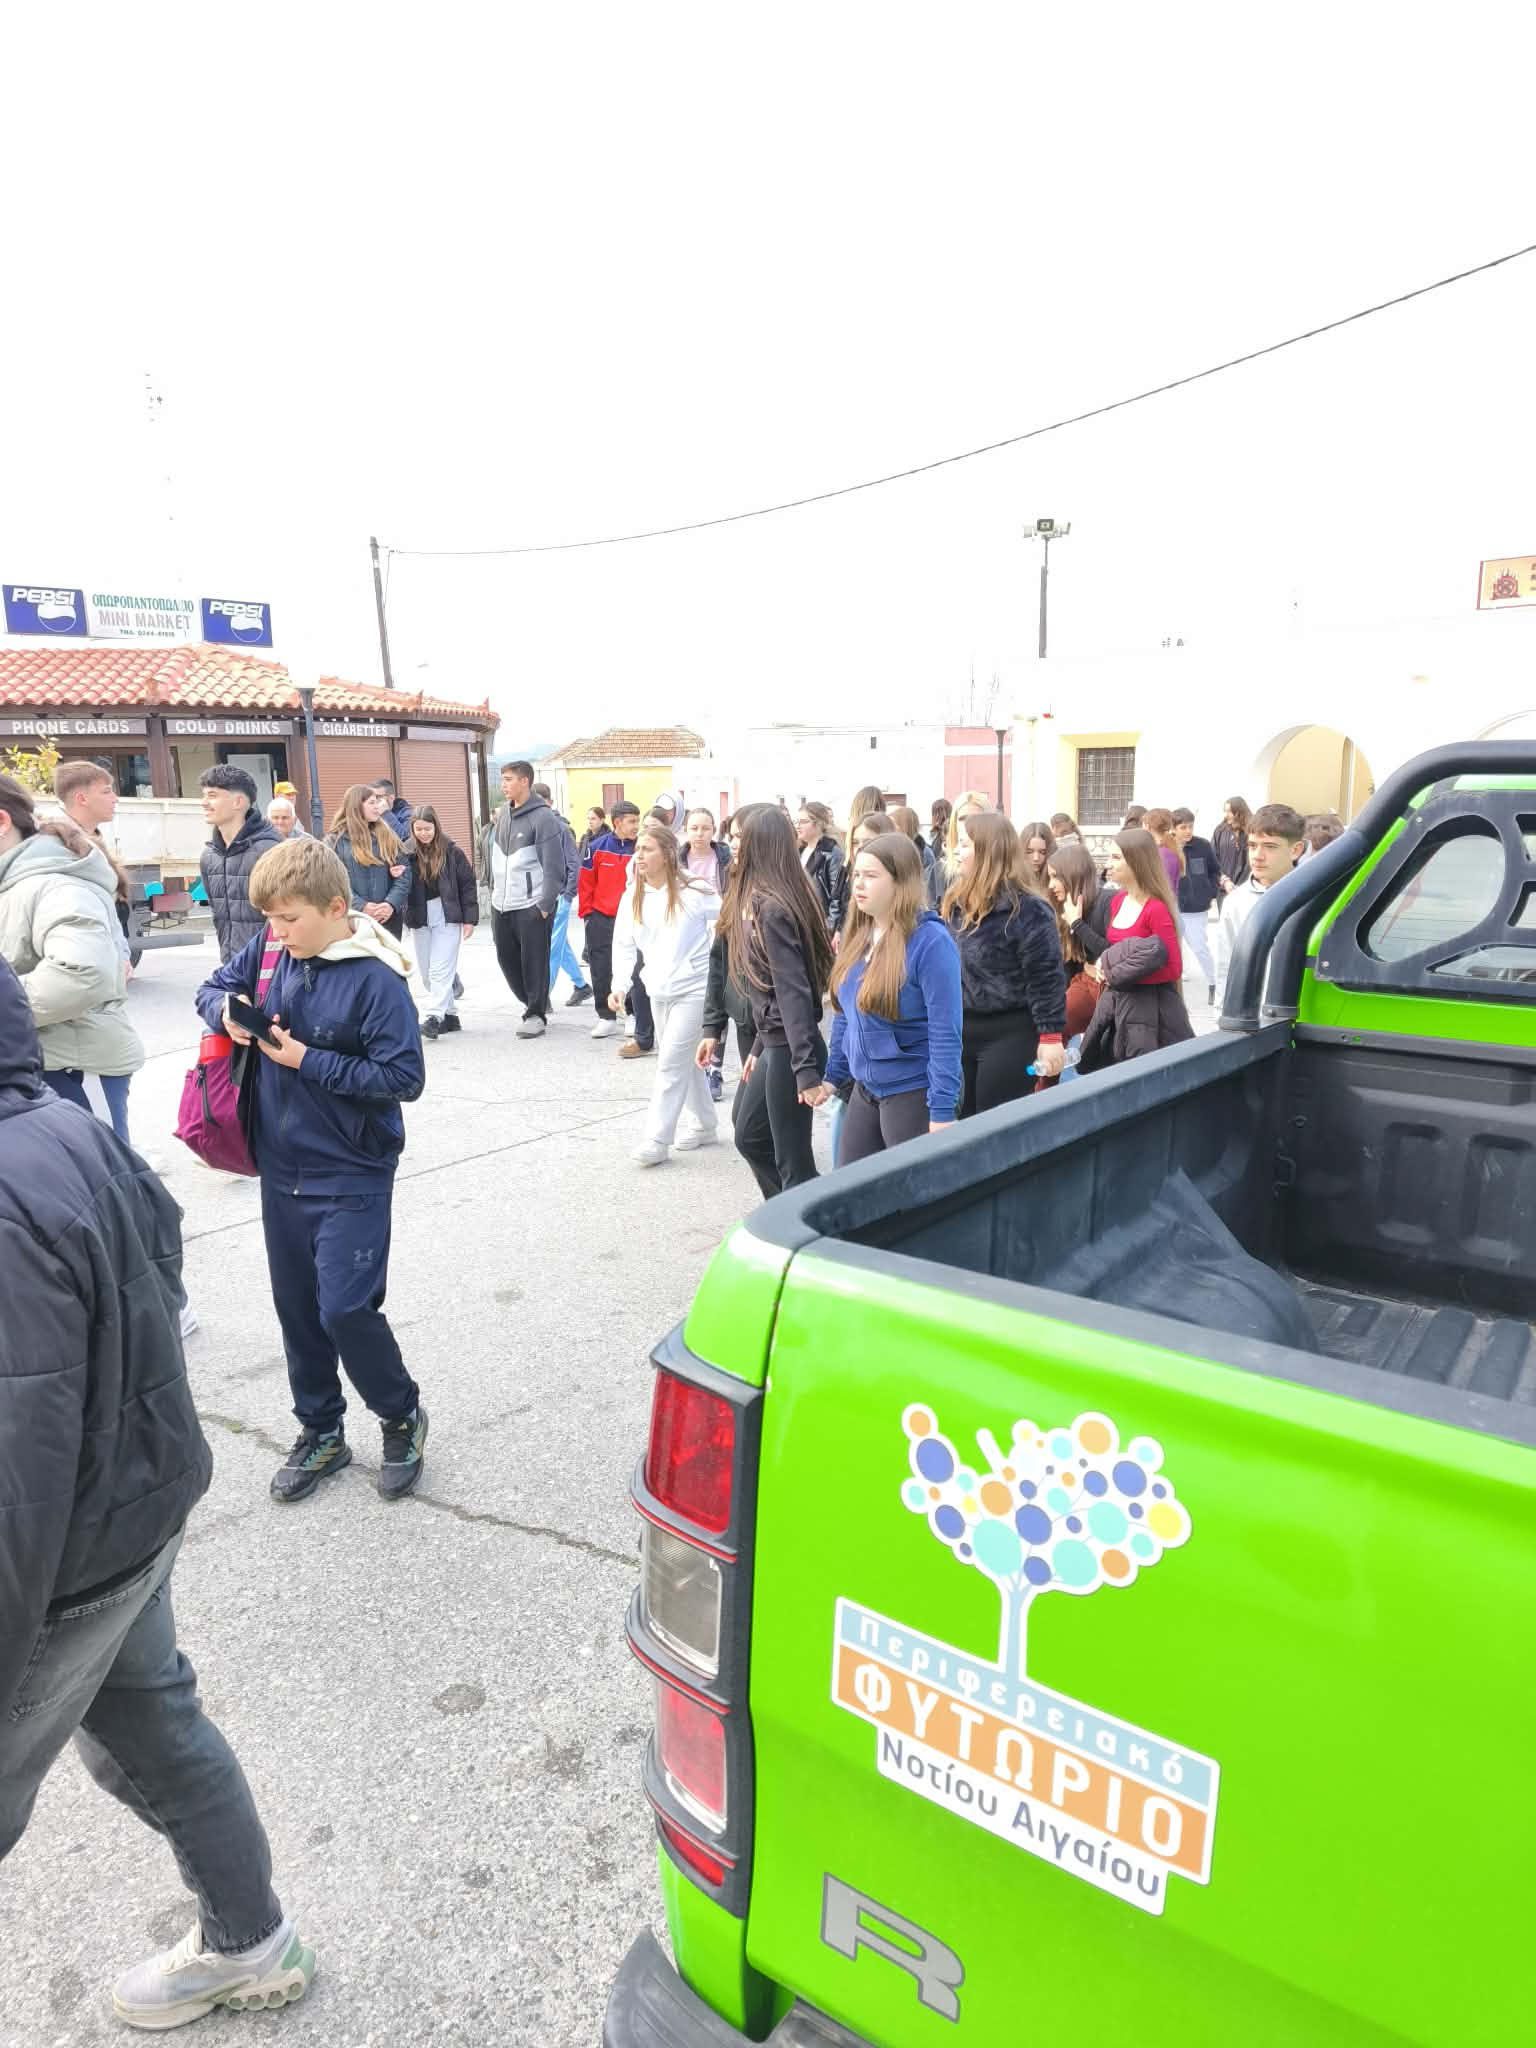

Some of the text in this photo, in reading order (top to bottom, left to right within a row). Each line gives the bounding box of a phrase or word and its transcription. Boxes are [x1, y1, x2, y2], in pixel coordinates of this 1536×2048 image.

[12, 587, 75, 606] PEPSI
[92, 594, 194, 613] ΟΠΩΡΟΠΑΝΤΟΠΩΛΙΟ
[209, 601, 264, 619] PEPSI
[99, 610, 191, 630] MINI MARKET
[12, 720, 130, 735] PHONE CARDS
[175, 720, 281, 735] COLD DRINKS
[322, 722, 388, 737] CIGARETTES
[860, 1614, 1184, 1785] Περιφερειακό
[854, 1663, 1183, 1857] ΦΥΤΩΡΙΟ
[882, 1731, 1159, 1897] Νοτίου Αιγαίου
